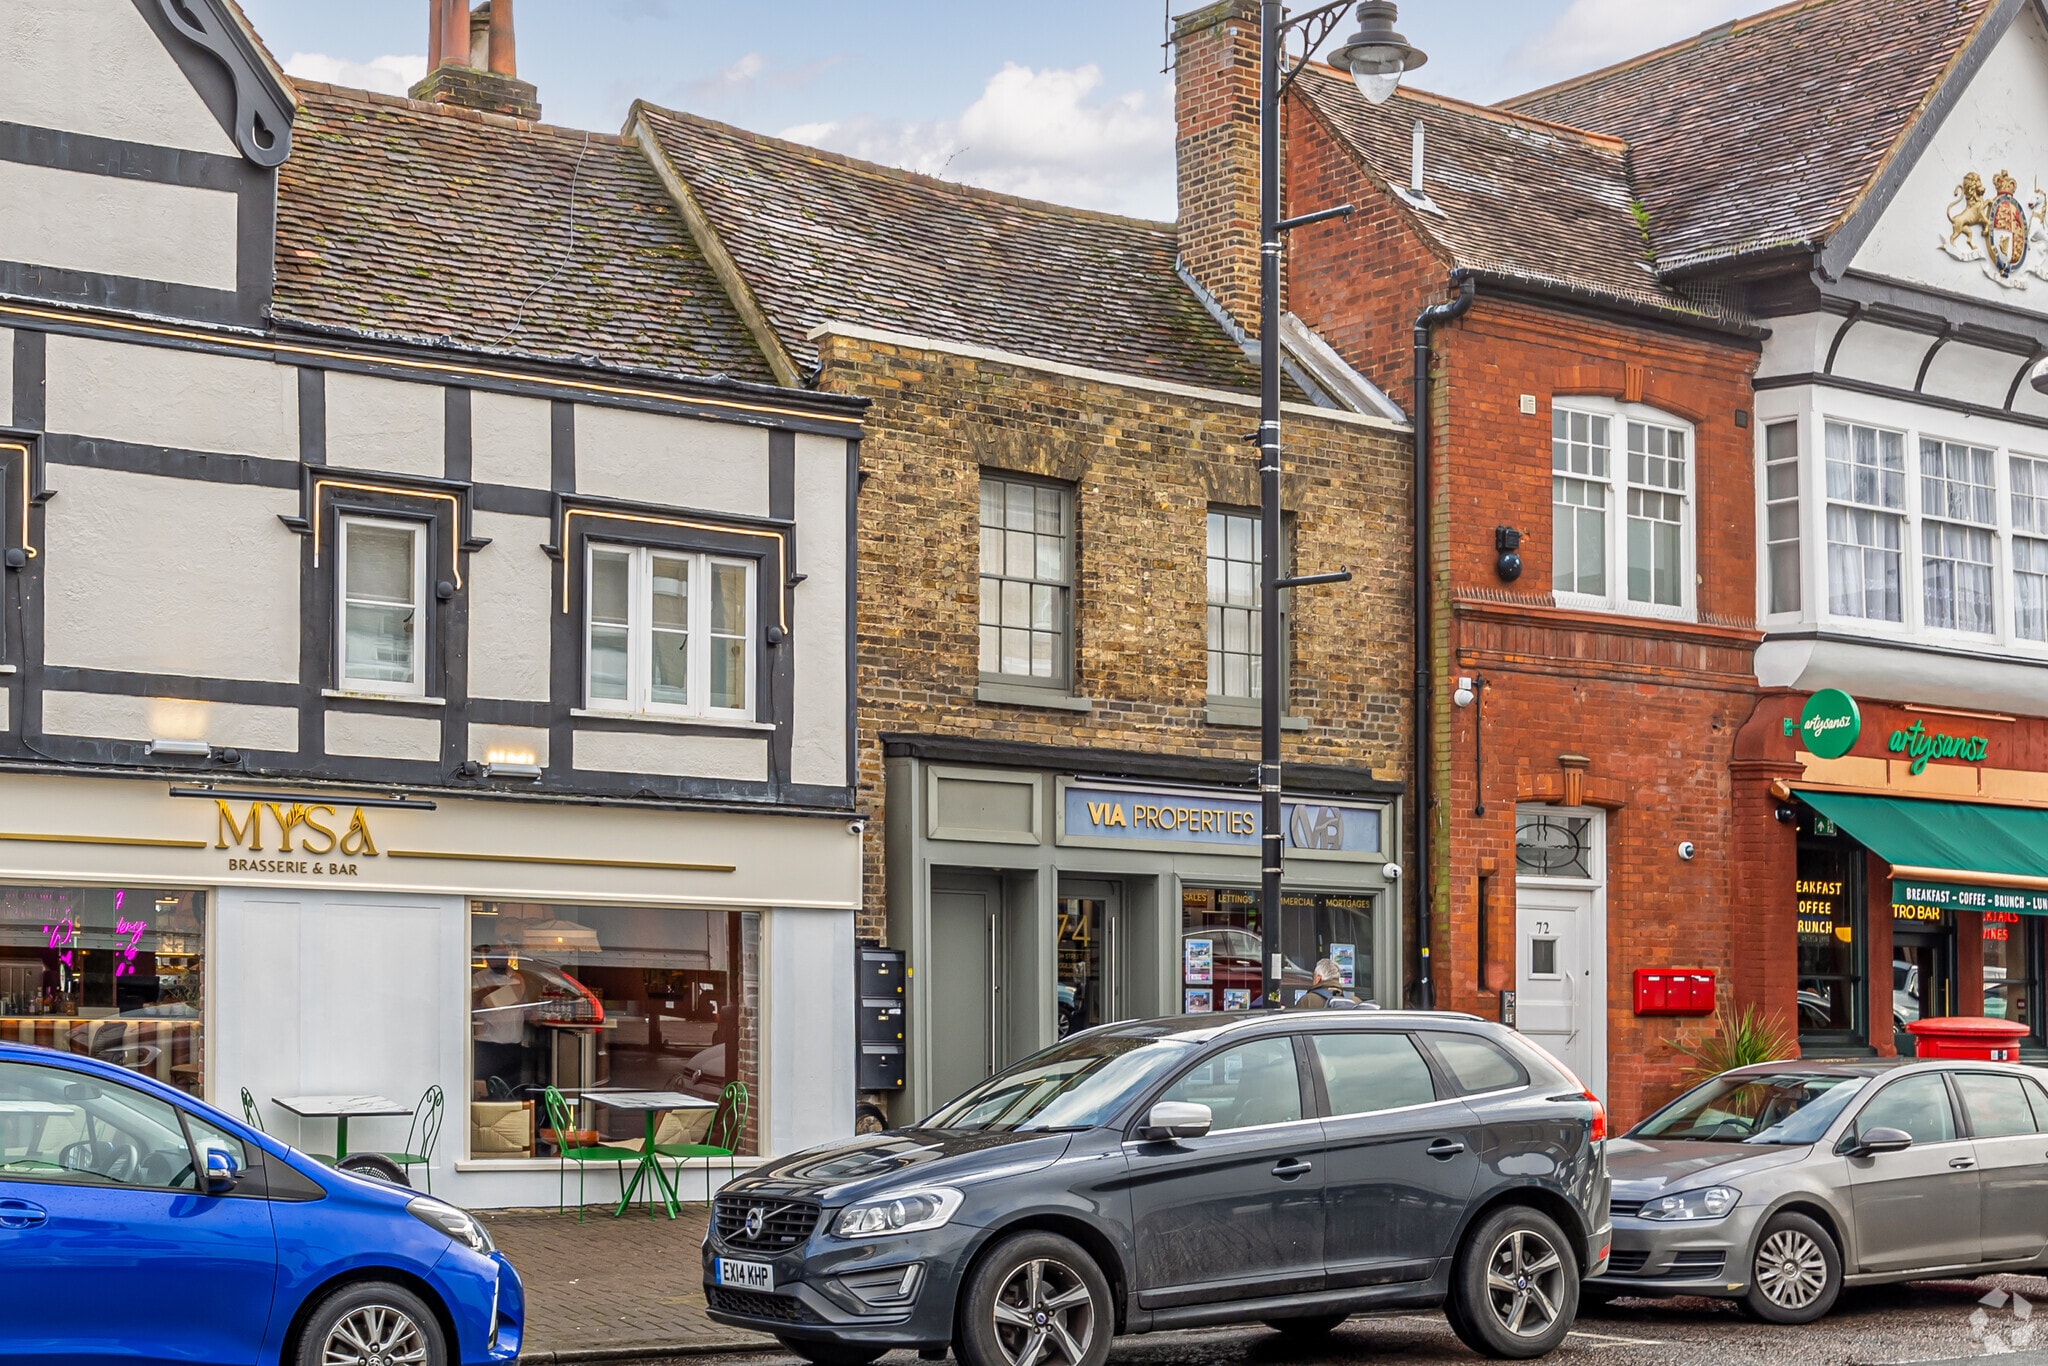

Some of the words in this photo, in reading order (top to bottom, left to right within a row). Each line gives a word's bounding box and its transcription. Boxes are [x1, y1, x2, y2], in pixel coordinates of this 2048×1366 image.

[1804, 714, 1851, 737] artysansz
[1888, 719, 1989, 775] artysansz
[215, 799, 380, 857] MYSA
[1087, 801, 1127, 827] VIA
[1133, 804, 1255, 834] PROPERTIES
[229, 859, 308, 874] BRASSERIE
[312, 862, 323, 874] &
[329, 863, 358, 876] BAR
[1183, 893, 1207, 902] SALES
[1218, 894, 1254, 904] LETTINGS
[1326, 899, 1370, 909] MORTGAGES
[1797, 901, 1831, 914] OFFEE
[1906, 887, 1950, 903] BREAKFAST
[1958, 891, 1986, 906] COFFEE
[1994, 894, 2025, 909] BRUNCH
[1917, 905, 1940, 920] BAR
[1983, 911, 2020, 923] KTAILS
[1057, 914, 1091, 947] 74
[1536, 921, 1550, 935] 72
[723, 1261, 746, 1284] EX14
[747, 1264, 768, 1287] KHP
